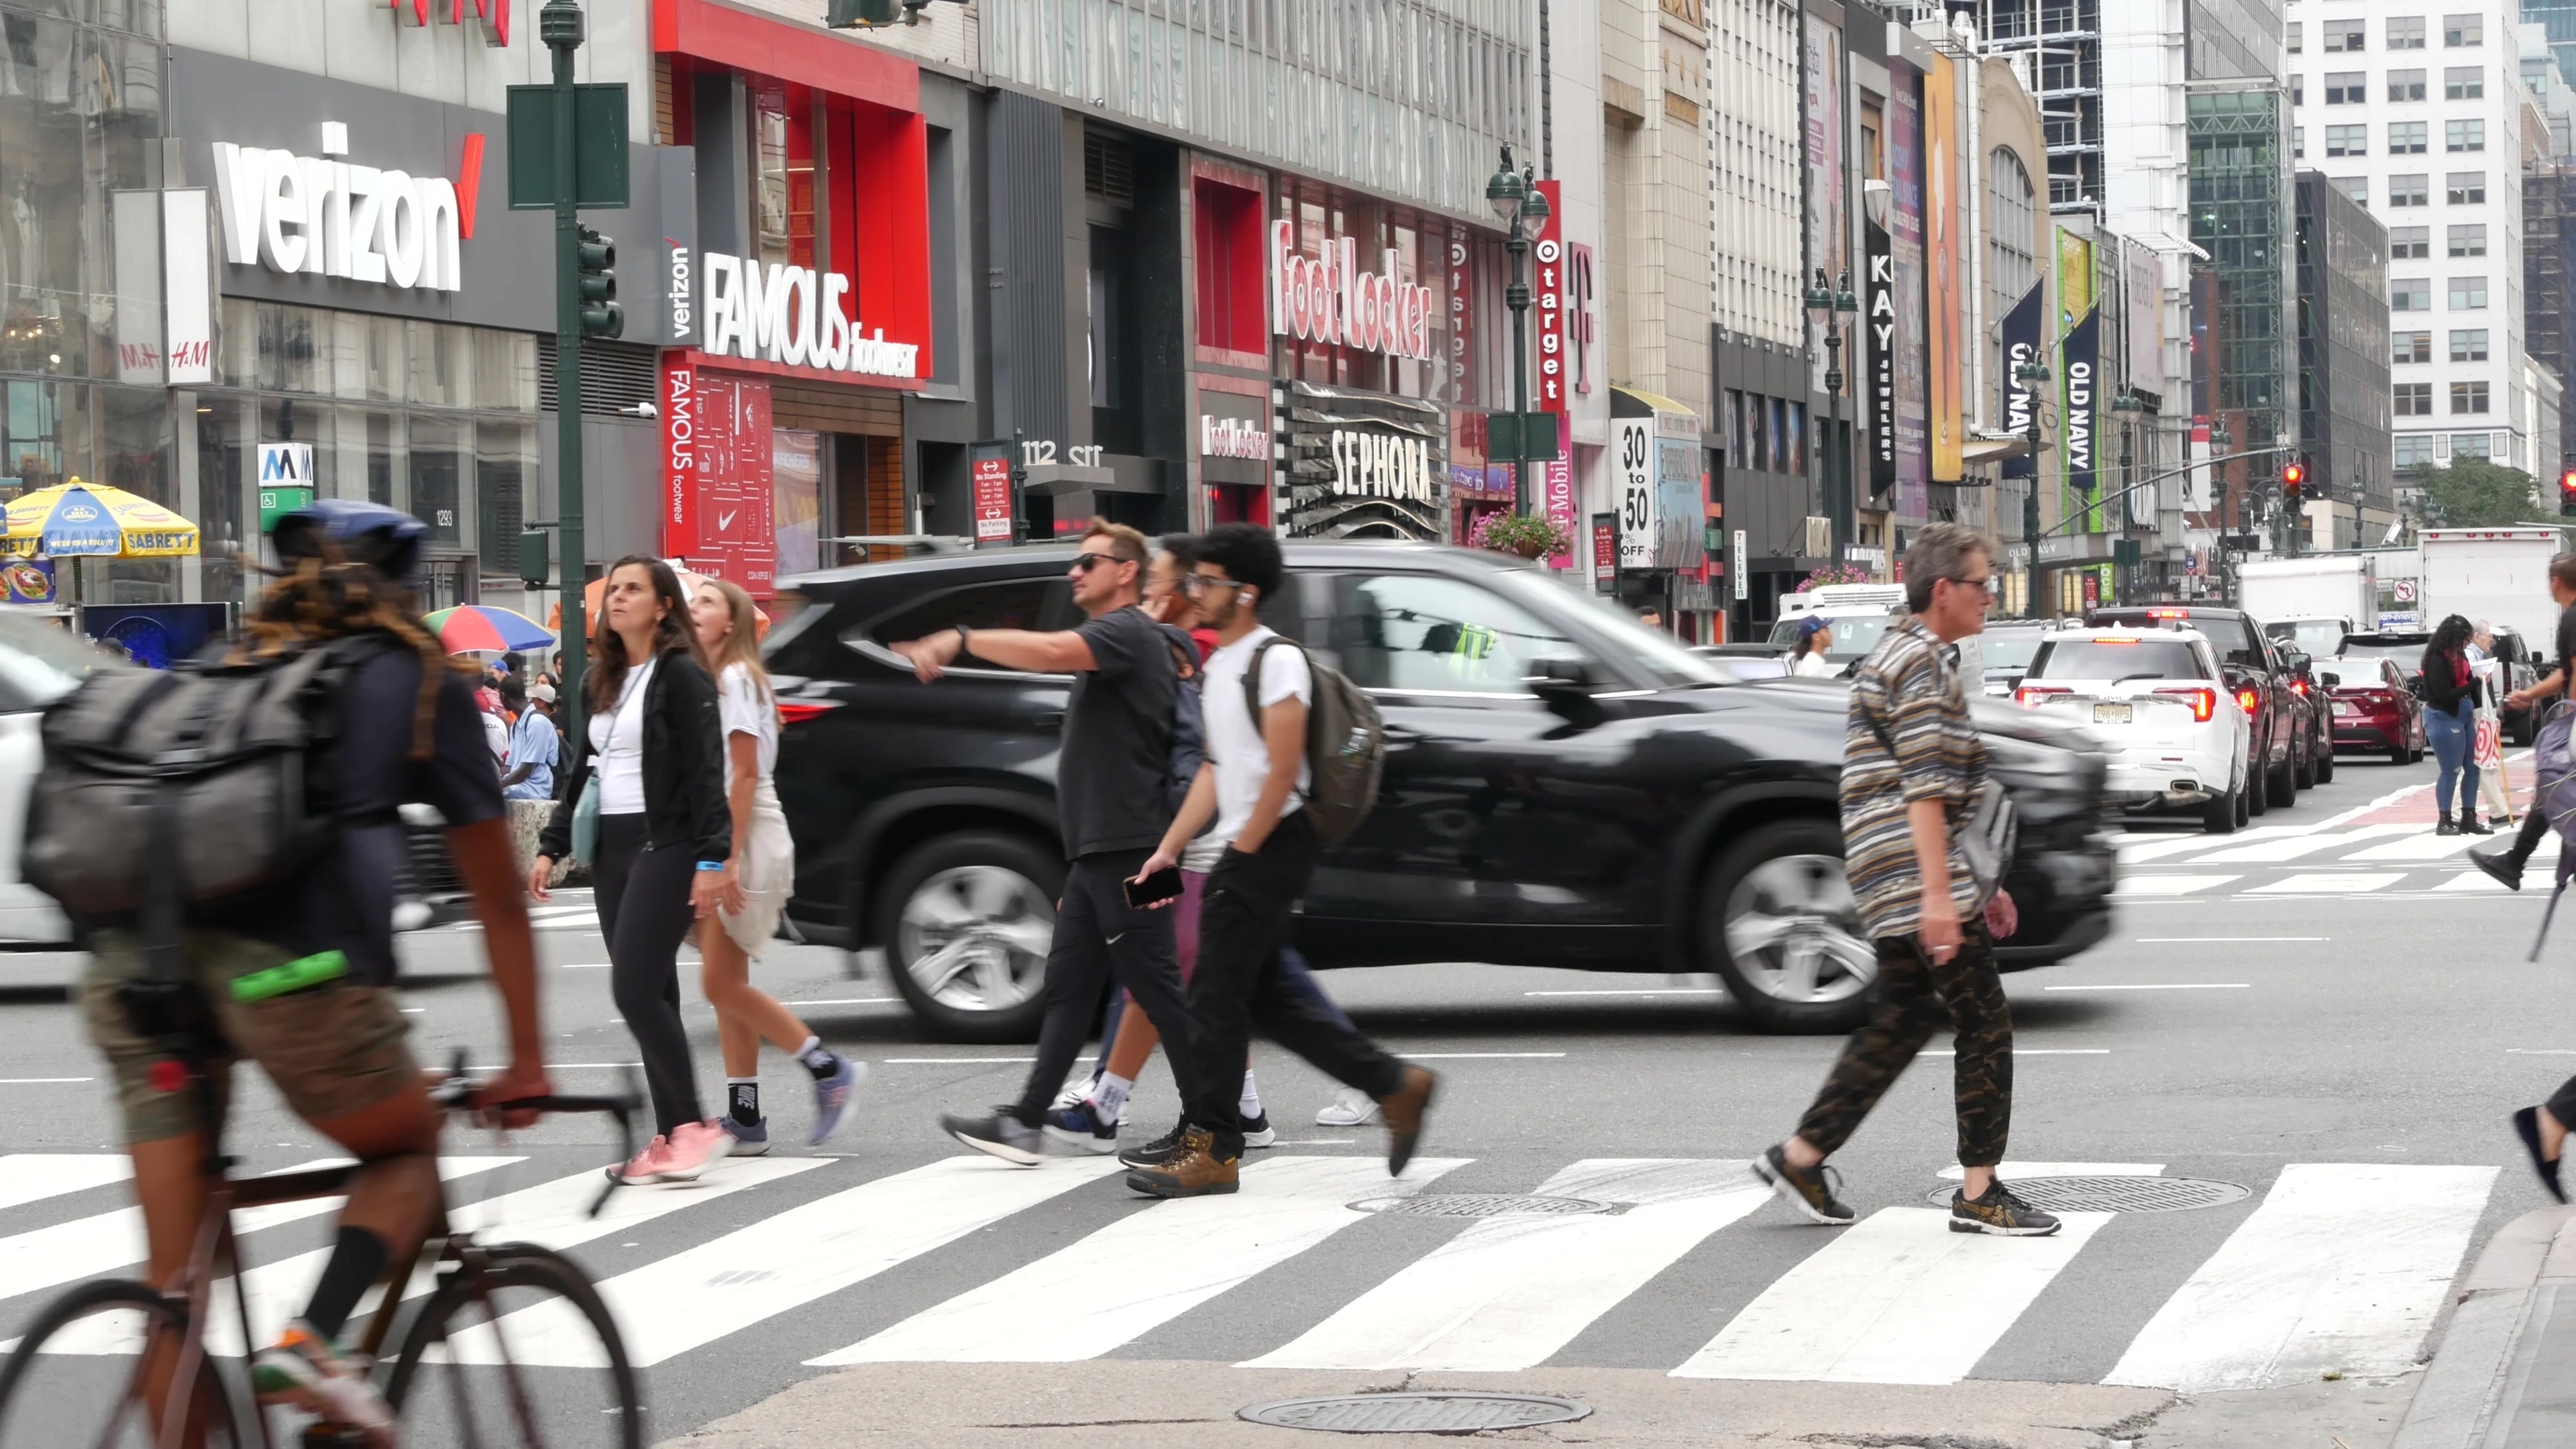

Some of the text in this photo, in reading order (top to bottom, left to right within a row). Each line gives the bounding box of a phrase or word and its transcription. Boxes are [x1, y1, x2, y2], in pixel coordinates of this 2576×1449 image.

[212, 121, 461, 291] verizon
[669, 248, 690, 338] verizon
[704, 252, 918, 378] FAMOUS footwear
[1871, 255, 1894, 352] KAY
[170, 341, 209, 368] H&M
[1542, 268, 1558, 399] target
[1880, 359, 1892, 462] JEWELERS
[2068, 362, 2091, 470] OLD NAVY
[671, 370, 692, 525] FAMOUS footwear
[1022, 440, 1057, 465] 112
[1332, 430, 1431, 500] SEPHORA
[1623, 425, 1646, 470] 30
[1629, 472, 1646, 484] to
[437, 510, 452, 526] 1293
[1625, 488, 1648, 531] 50
[127, 533, 195, 549] SABRETT
[1621, 545, 1645, 556] OFF
[2008, 547, 2028, 557] OLD
